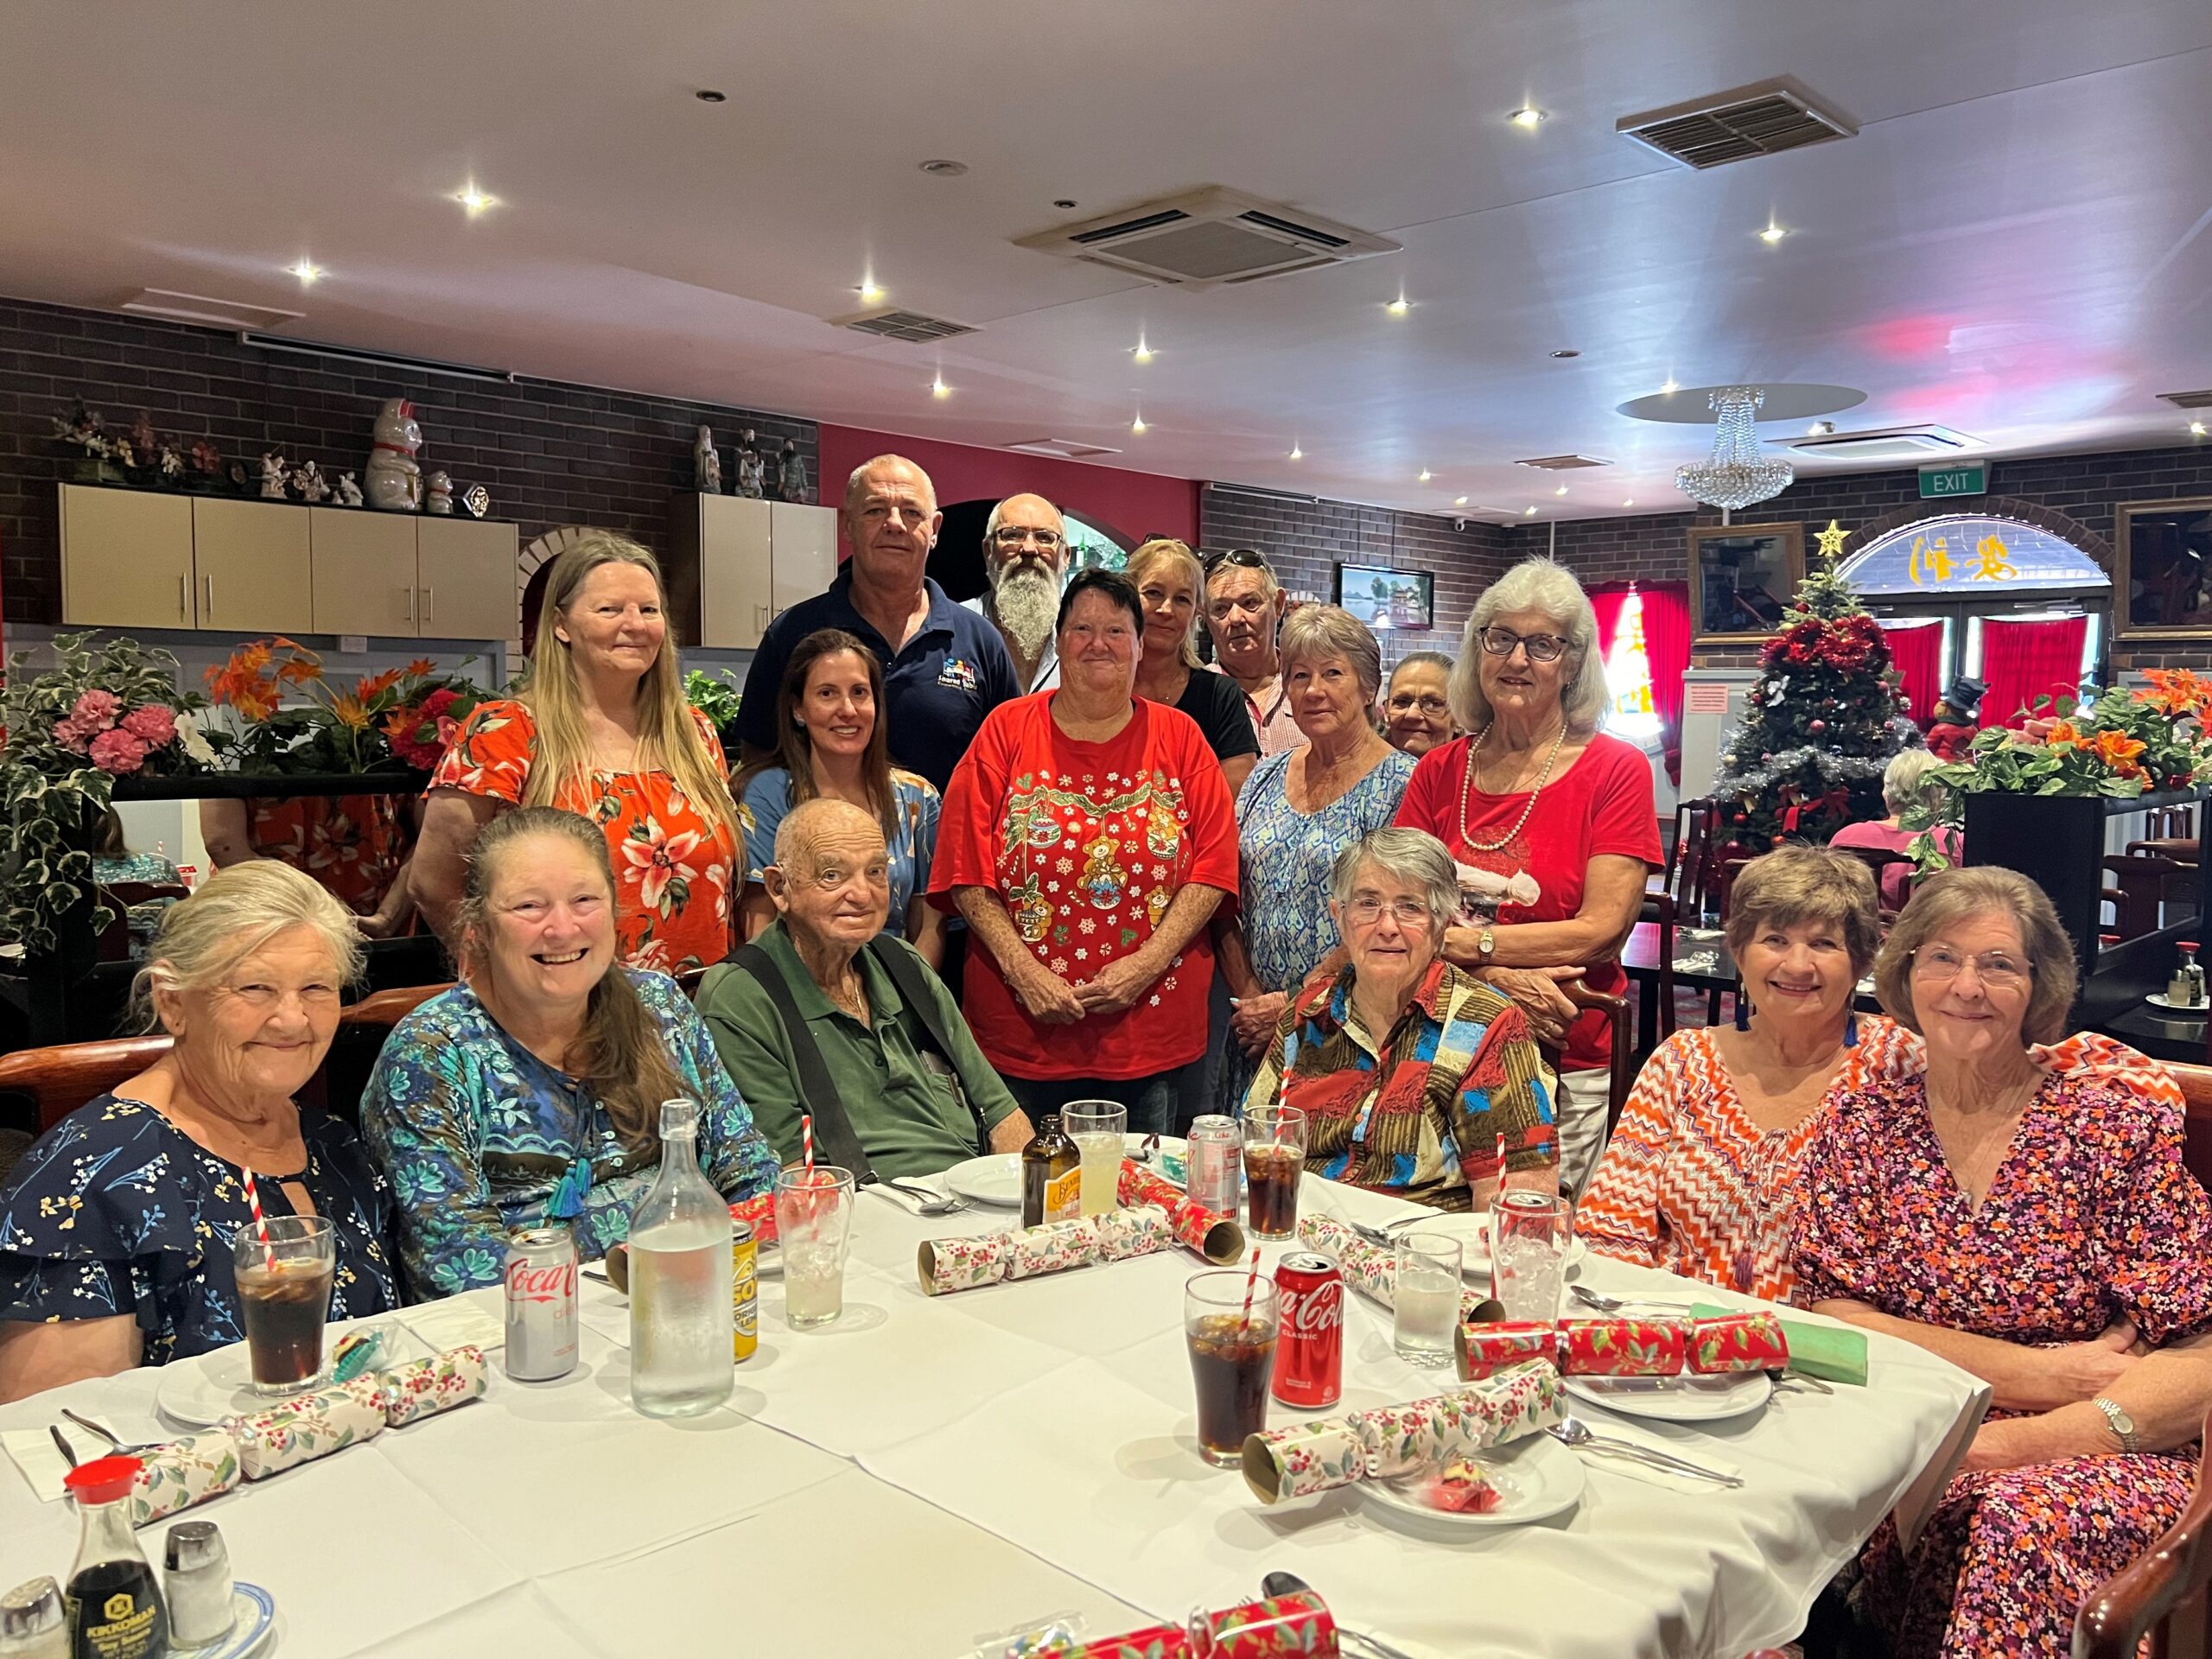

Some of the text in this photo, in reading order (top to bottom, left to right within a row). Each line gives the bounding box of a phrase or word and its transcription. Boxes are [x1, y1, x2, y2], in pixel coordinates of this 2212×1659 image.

[1933, 473, 1968, 492] EXIT
[1282, 1329, 1318, 1340] CLASSIC
[86, 1605, 156, 1638] KIKKOMAN
